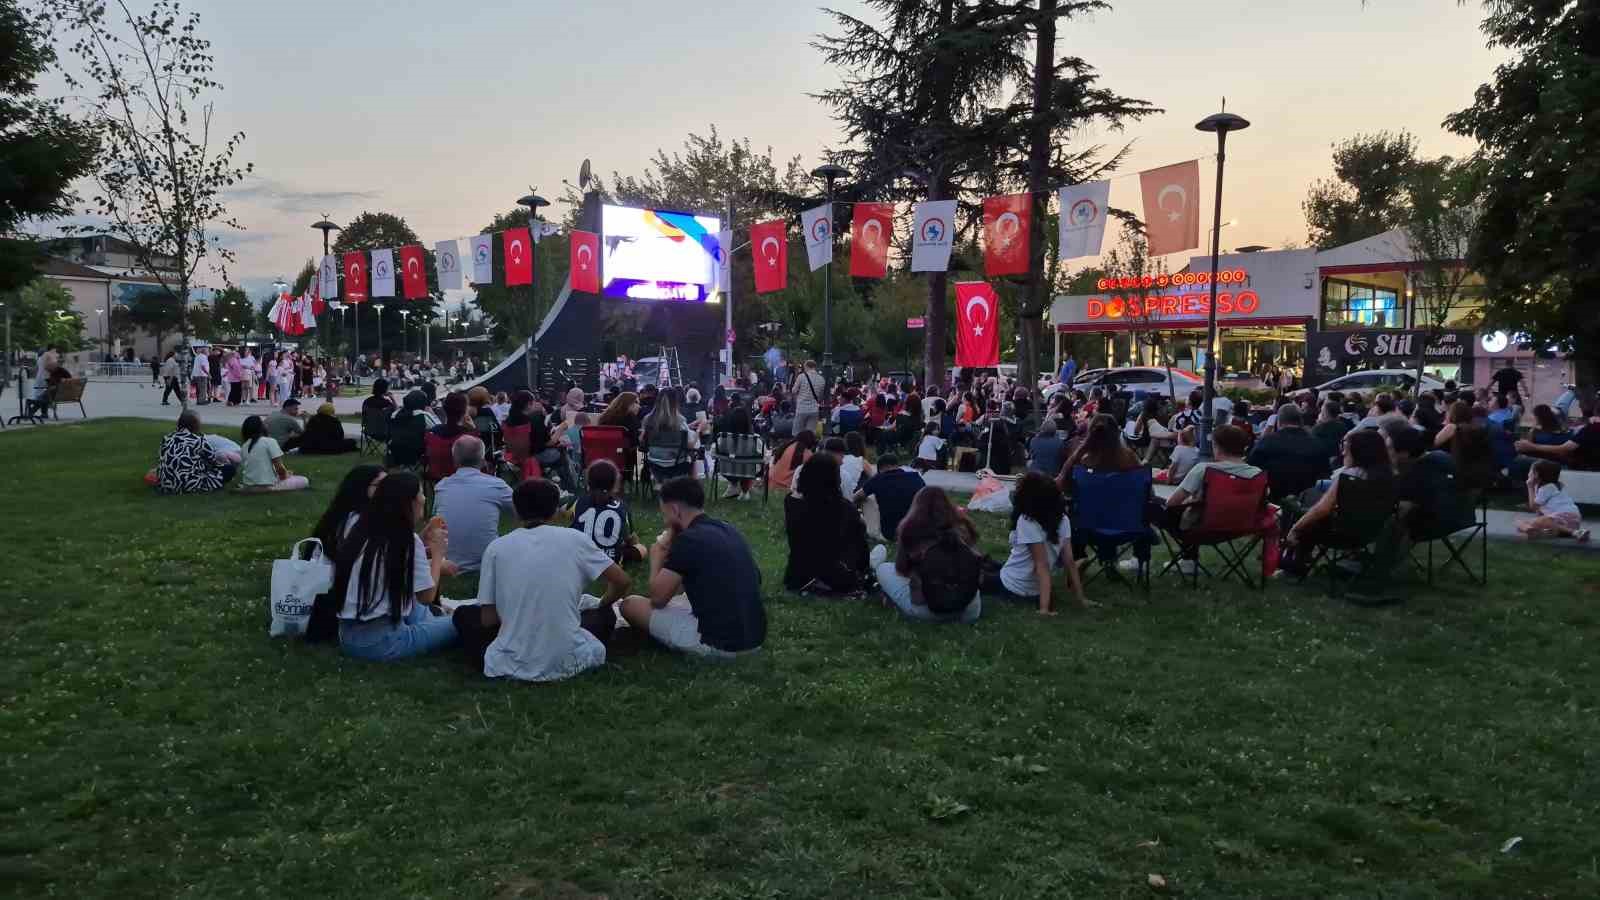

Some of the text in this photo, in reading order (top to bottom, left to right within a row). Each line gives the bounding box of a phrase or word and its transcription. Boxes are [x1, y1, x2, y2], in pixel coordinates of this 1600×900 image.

[1172, 269, 1246, 286] COFEE
[1087, 289, 1260, 319] DOSPRESSO
[1373, 333, 1414, 356] Stil
[578, 507, 621, 547] 10
